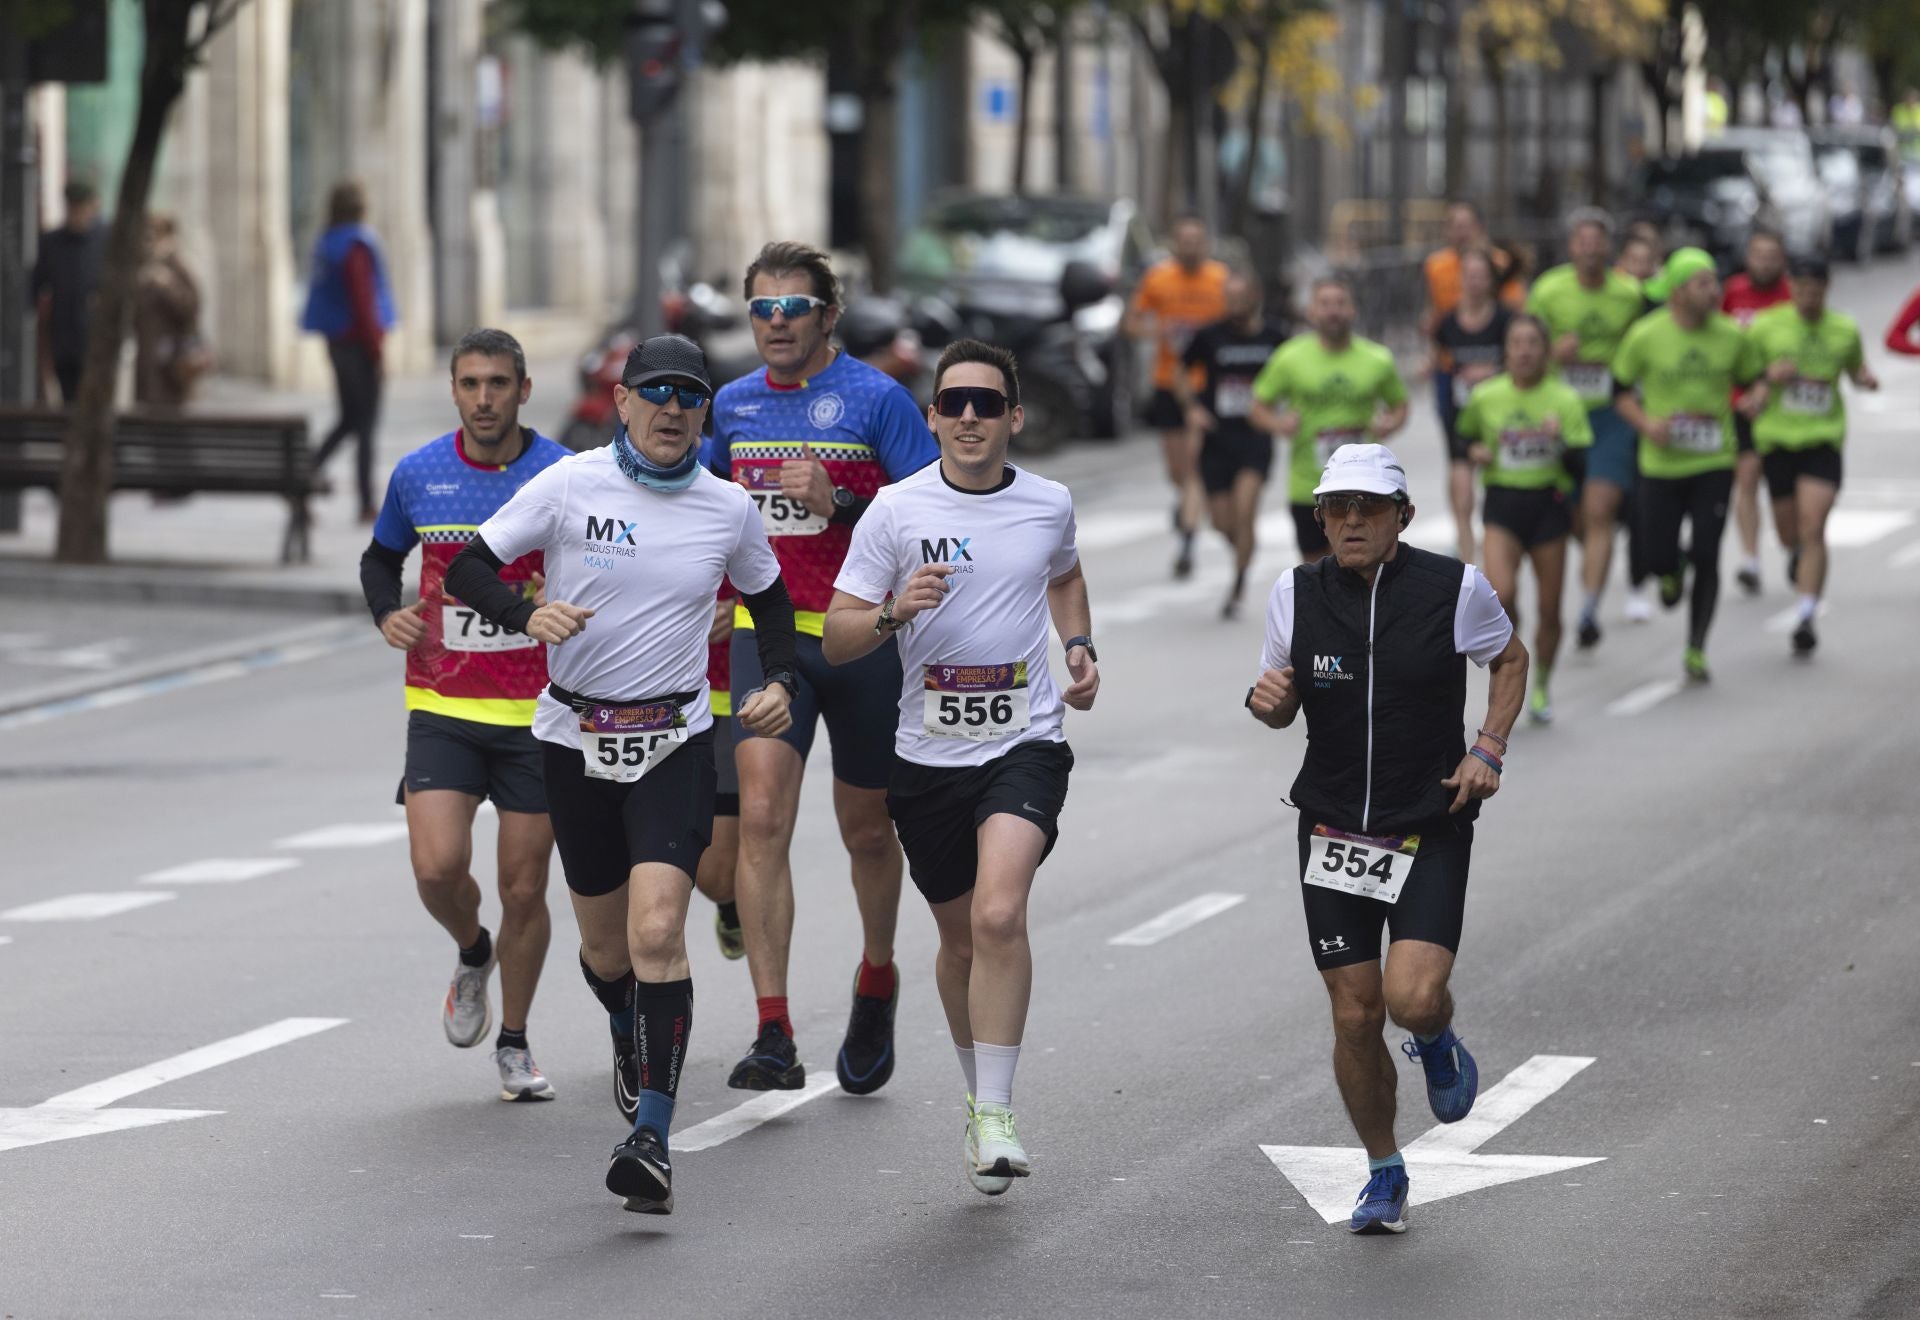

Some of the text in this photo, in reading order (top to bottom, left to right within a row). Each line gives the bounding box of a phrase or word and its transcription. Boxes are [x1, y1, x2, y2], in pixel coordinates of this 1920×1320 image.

[586, 515, 638, 546] MX
[584, 542, 637, 558] INDUSTRIAS
[921, 537, 973, 564] MX
[584, 555, 615, 571] MAXI
[456, 611, 520, 638] 75
[987, 667, 996, 675] DE
[1313, 654, 1342, 672] MX
[956, 674, 996, 683] EMPRESAS
[1313, 671, 1354, 680] INDUSTRIAS
[938, 694, 1013, 726] 556
[614, 715, 654, 724] EMPRESAS
[1322, 841, 1394, 885] 554
